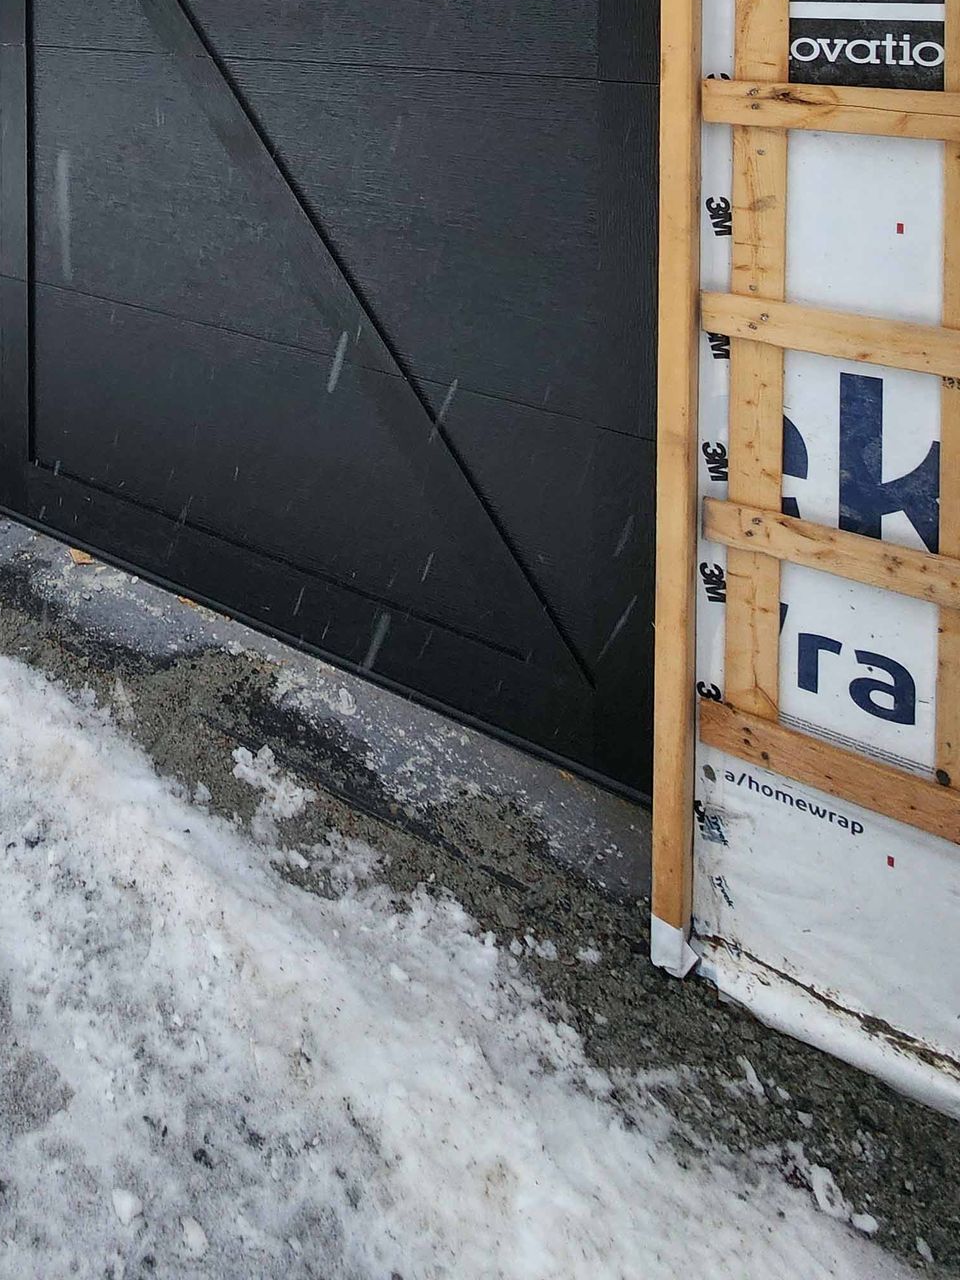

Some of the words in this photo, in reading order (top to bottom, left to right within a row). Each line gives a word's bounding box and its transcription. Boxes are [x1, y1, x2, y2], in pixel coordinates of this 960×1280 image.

[705, 196, 732, 237] 3M
[701, 442, 729, 482] 3M
[699, 562, 726, 604] 3M
[725, 770, 865, 836] a/homewrap
